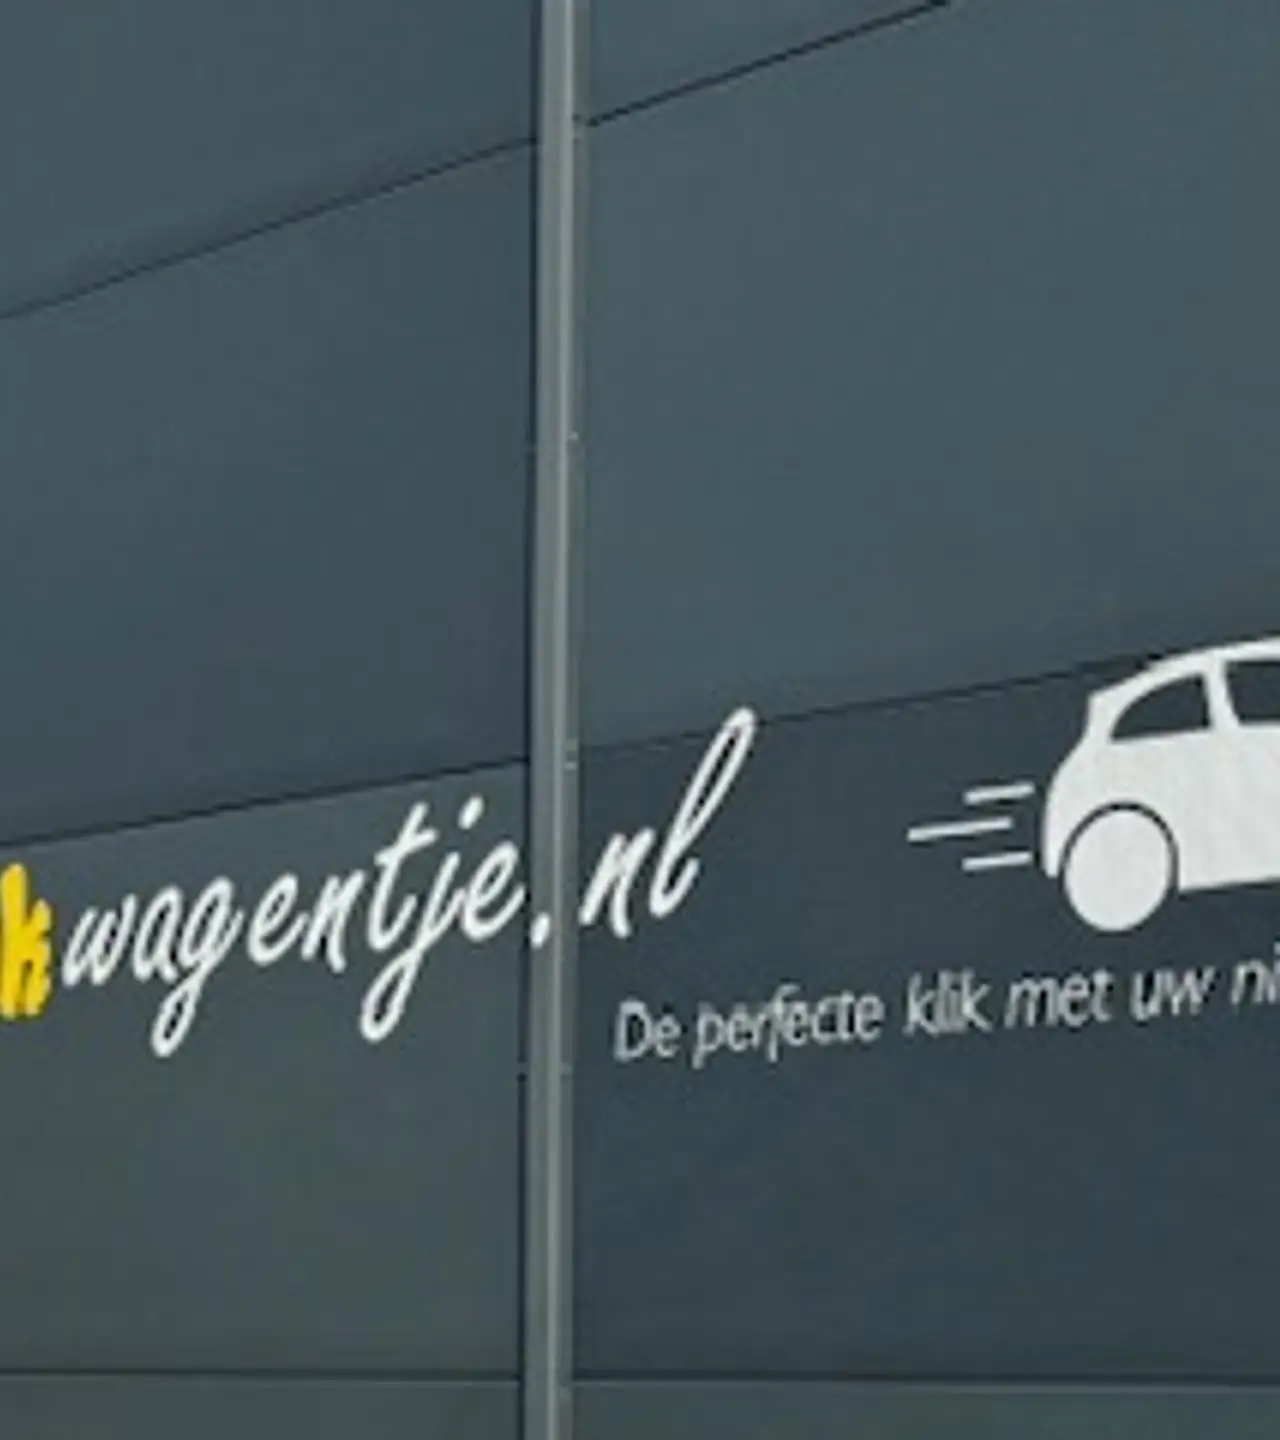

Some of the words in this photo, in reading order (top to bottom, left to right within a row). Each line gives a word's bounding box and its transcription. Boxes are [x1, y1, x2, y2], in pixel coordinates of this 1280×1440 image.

[612, 999, 682, 1062] De
[690, 984, 887, 1070] perfecte
[901, 968, 993, 1037] klik
[1004, 973, 1116, 1029] met
[1129, 966, 1217, 1022] uw
